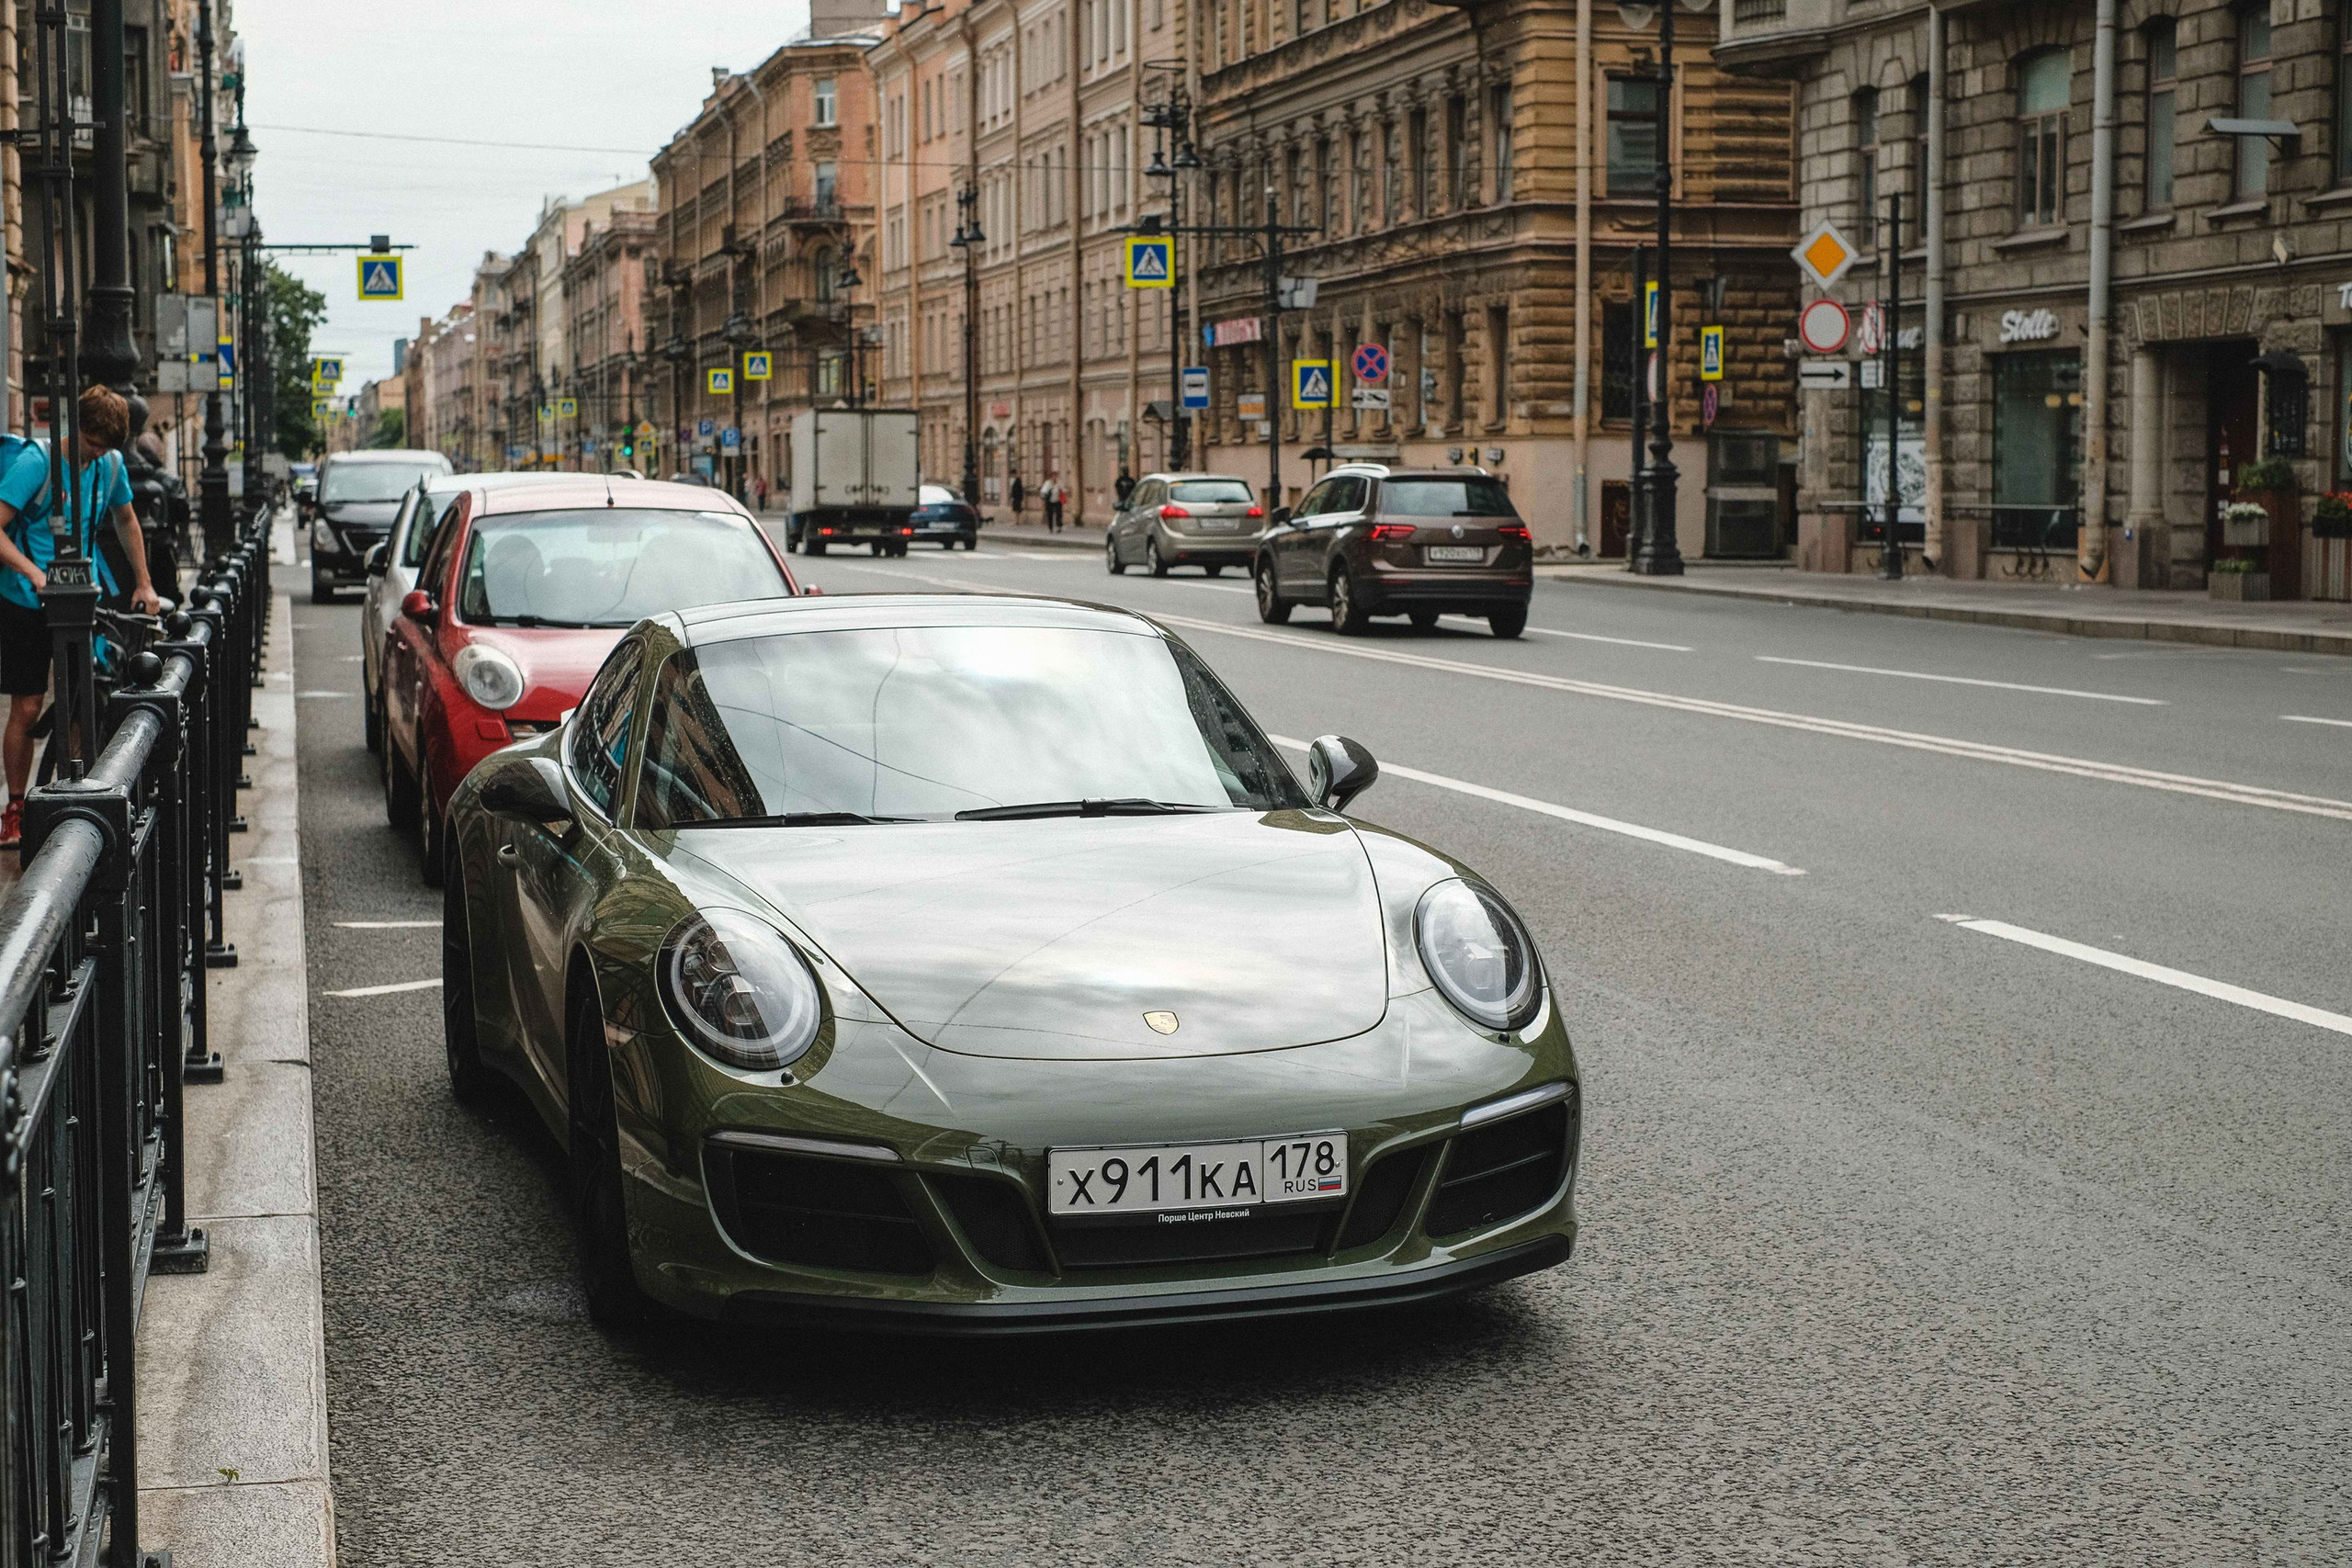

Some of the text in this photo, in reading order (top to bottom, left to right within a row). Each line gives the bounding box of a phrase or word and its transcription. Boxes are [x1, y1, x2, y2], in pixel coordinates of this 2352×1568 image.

[1270, 1141, 1335, 1179] 178
[1283, 1179, 1317, 1194] RUS
[1158, 1208, 1250, 1224] Порше Центр Невский
